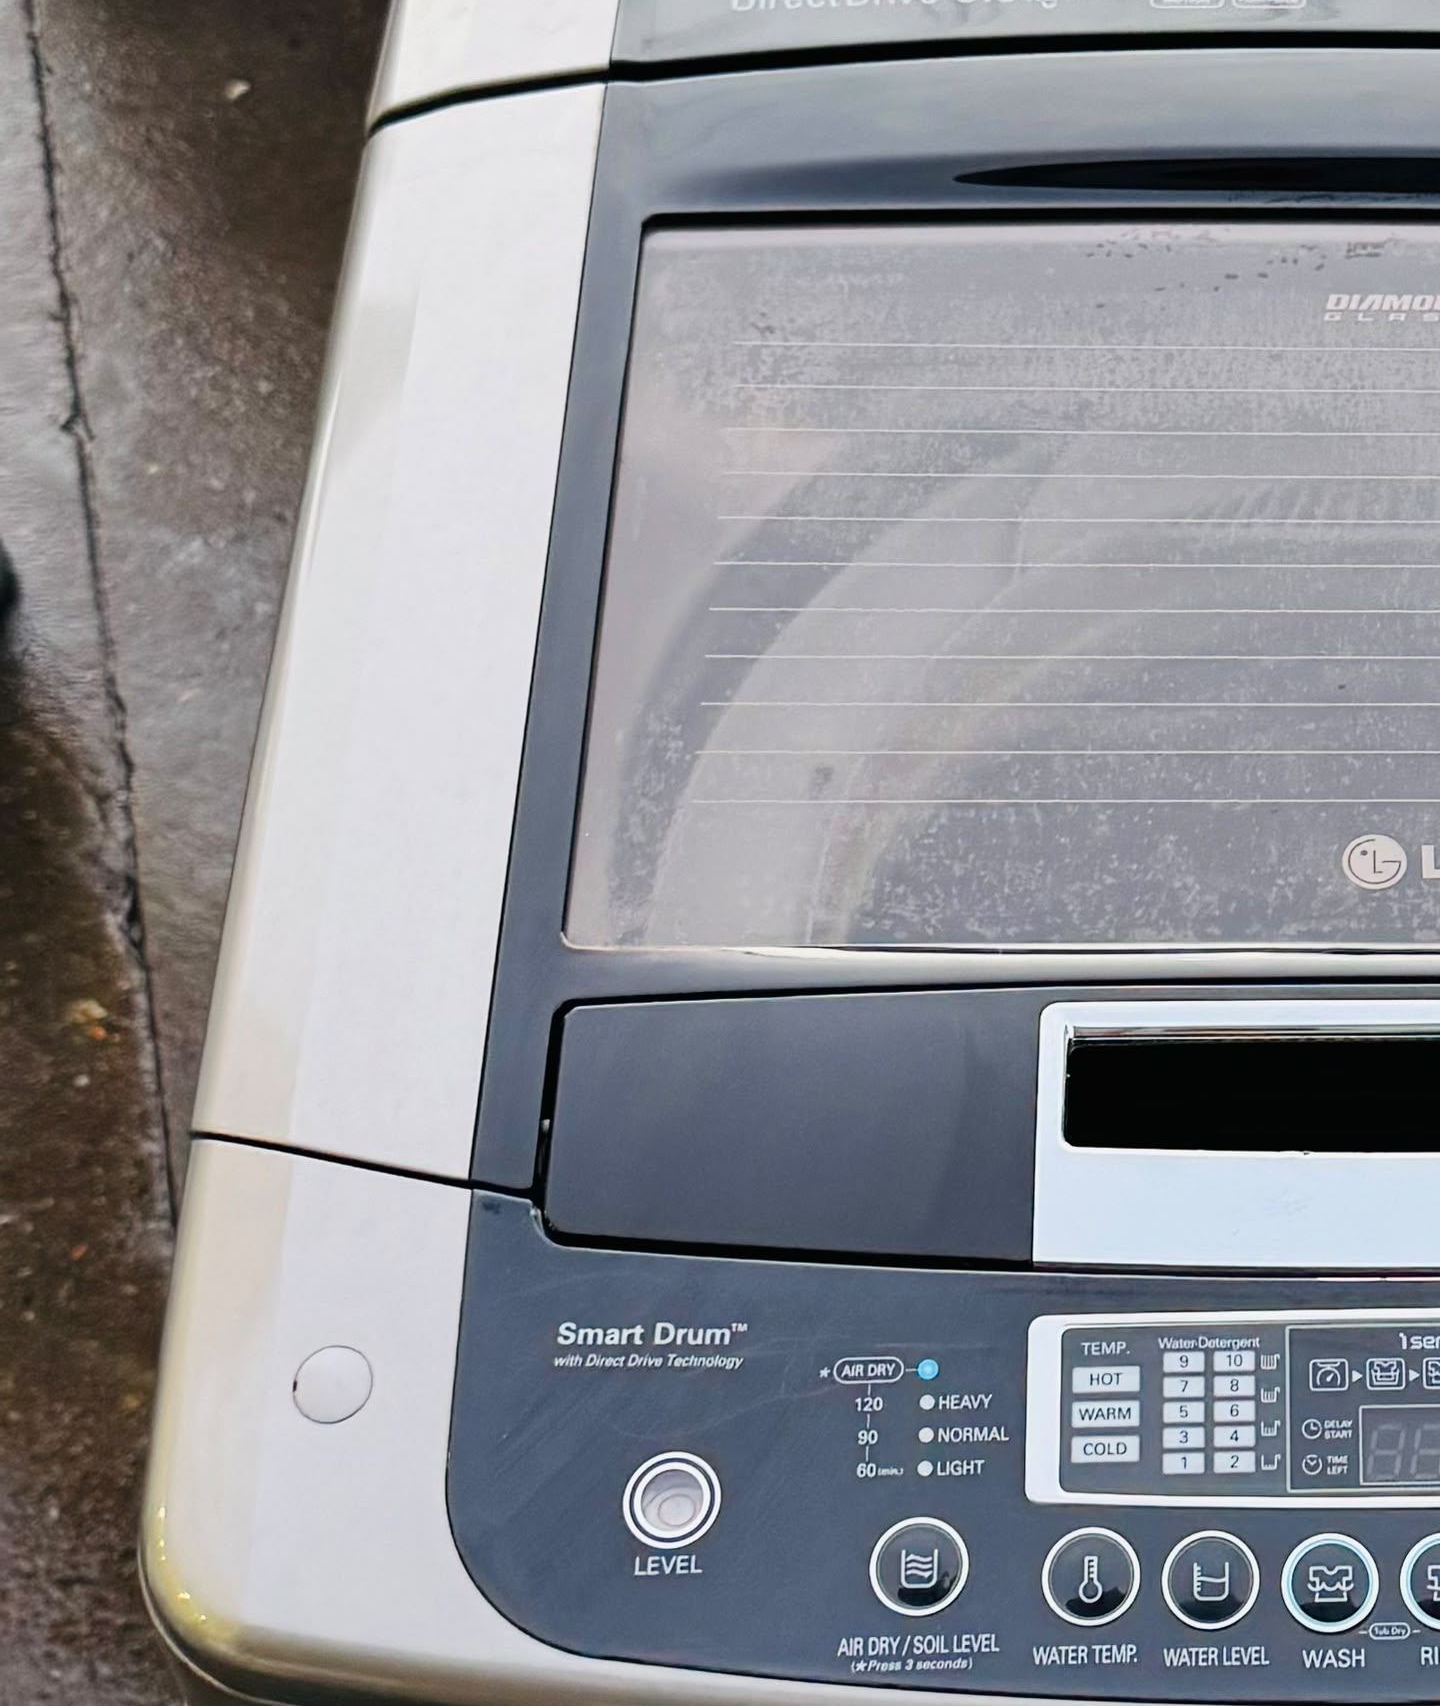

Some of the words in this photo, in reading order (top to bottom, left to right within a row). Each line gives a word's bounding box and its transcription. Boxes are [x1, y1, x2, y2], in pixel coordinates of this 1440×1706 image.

[557, 1321, 645, 1345] Smart
[1081, 1341, 1130, 1357] TEMP.
[554, 1354, 583, 1367] with
[584, 1353, 625, 1367] Direct
[627, 1353, 663, 1367] Drive
[666, 1353, 744, 1369] Technology
[1179, 1354, 1188, 1368] 9
[1226, 1353, 1243, 1367] 10
[841, 1364, 865, 1378] AIR
[868, 1363, 896, 1377] DRY
[1089, 1372, 1123, 1386] HOT
[1179, 1380, 1188, 1393] 7
[1229, 1379, 1240, 1392] 8
[855, 1397, 884, 1412] 120
[938, 1394, 993, 1410] HEAVY
[1078, 1406, 1132, 1422] WARM
[1179, 1405, 1188, 1418] 5
[1229, 1404, 1240, 1418] 6
[1324, 1420, 1353, 1429] DELAY
[857, 1430, 879, 1445] 90
[937, 1426, 1010, 1443] NORMAL
[1179, 1430, 1188, 1444] 3
[1229, 1429, 1240, 1443] 4
[1324, 1429, 1353, 1440] START
[1082, 1442, 1128, 1457] COLD
[936, 1459, 985, 1476] LIGHT
[1180, 1456, 1187, 1469] 1
[1229, 1455, 1240, 1469] 2
[1326, 1455, 1349, 1465] TIME
[856, 1463, 877, 1478] 60
[1327, 1465, 1348, 1476] LEFT
[634, 1555, 703, 1576] LEVEL
[837, 1637, 864, 1657] AIR
[867, 1635, 901, 1656] DRY
[912, 1635, 950, 1655] SOIL
[952, 1634, 1001, 1653] LEVEL
[1033, 1646, 1089, 1665] WATER
[1092, 1645, 1138, 1663] TEMP.
[1163, 1647, 1221, 1667] WATER
[1223, 1646, 1270, 1665] LEVEL
[1302, 1649, 1366, 1668] WASH
